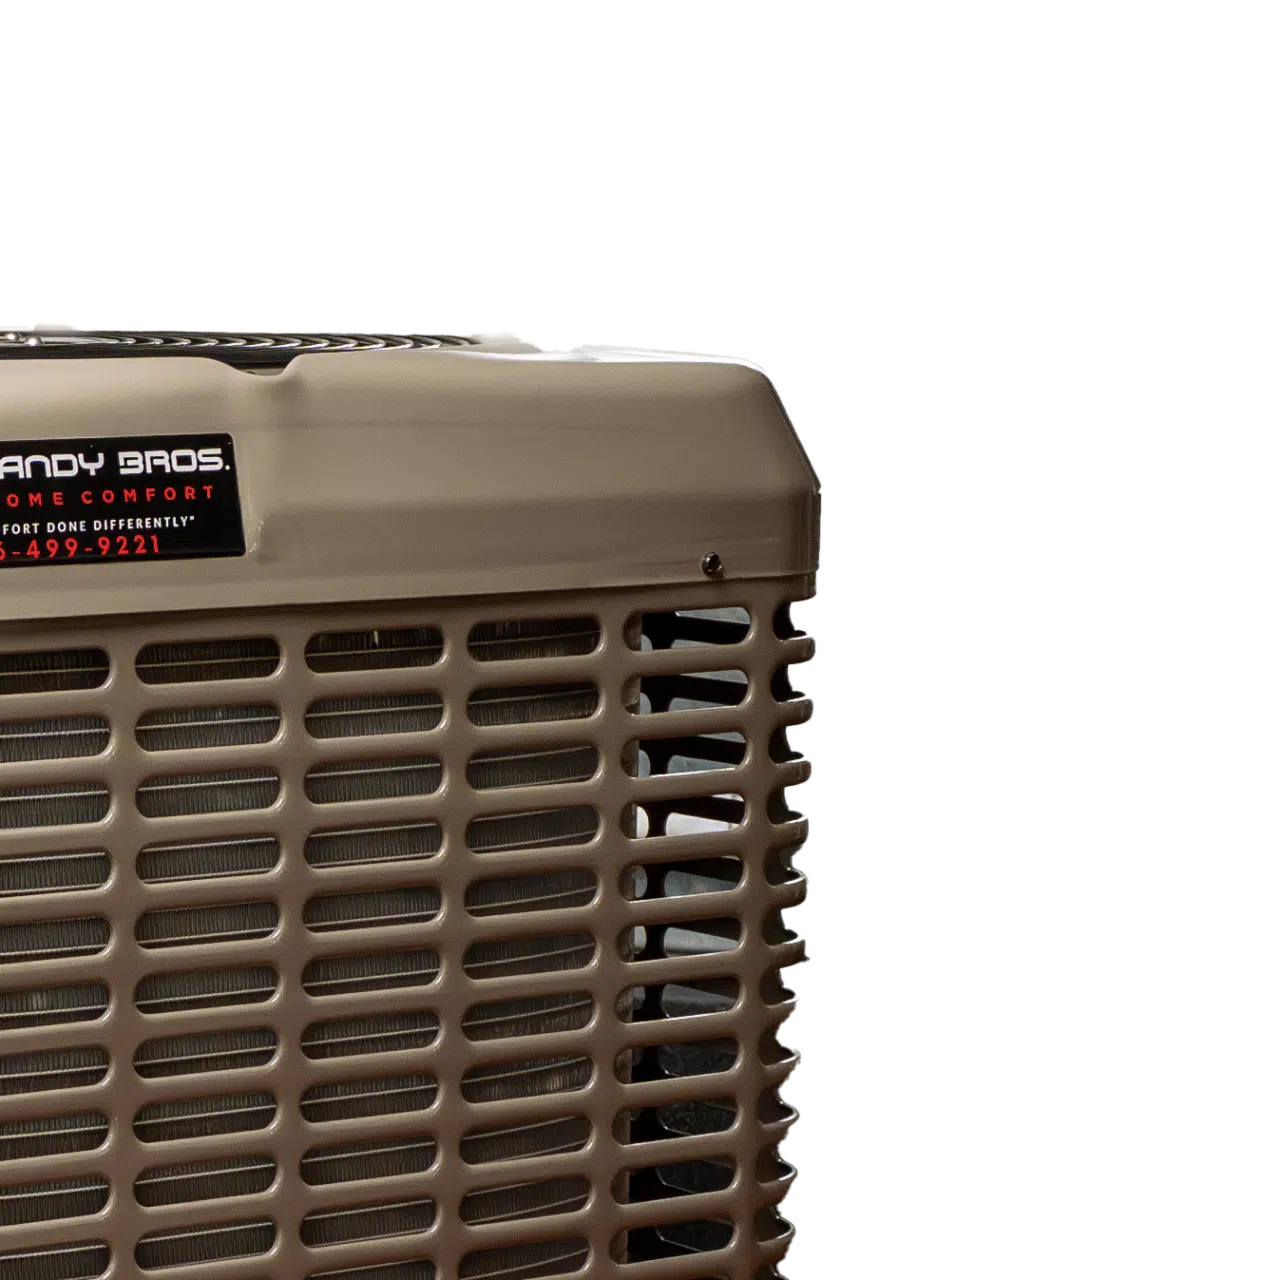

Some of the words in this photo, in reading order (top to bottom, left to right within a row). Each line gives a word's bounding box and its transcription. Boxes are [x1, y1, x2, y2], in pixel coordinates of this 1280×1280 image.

[117, 447, 231, 475] BROS.
[80, 485, 214, 505] COMFORT
[46, 520, 86, 533] DONE
[93, 515, 195, 531] DIFFERENTLY"
